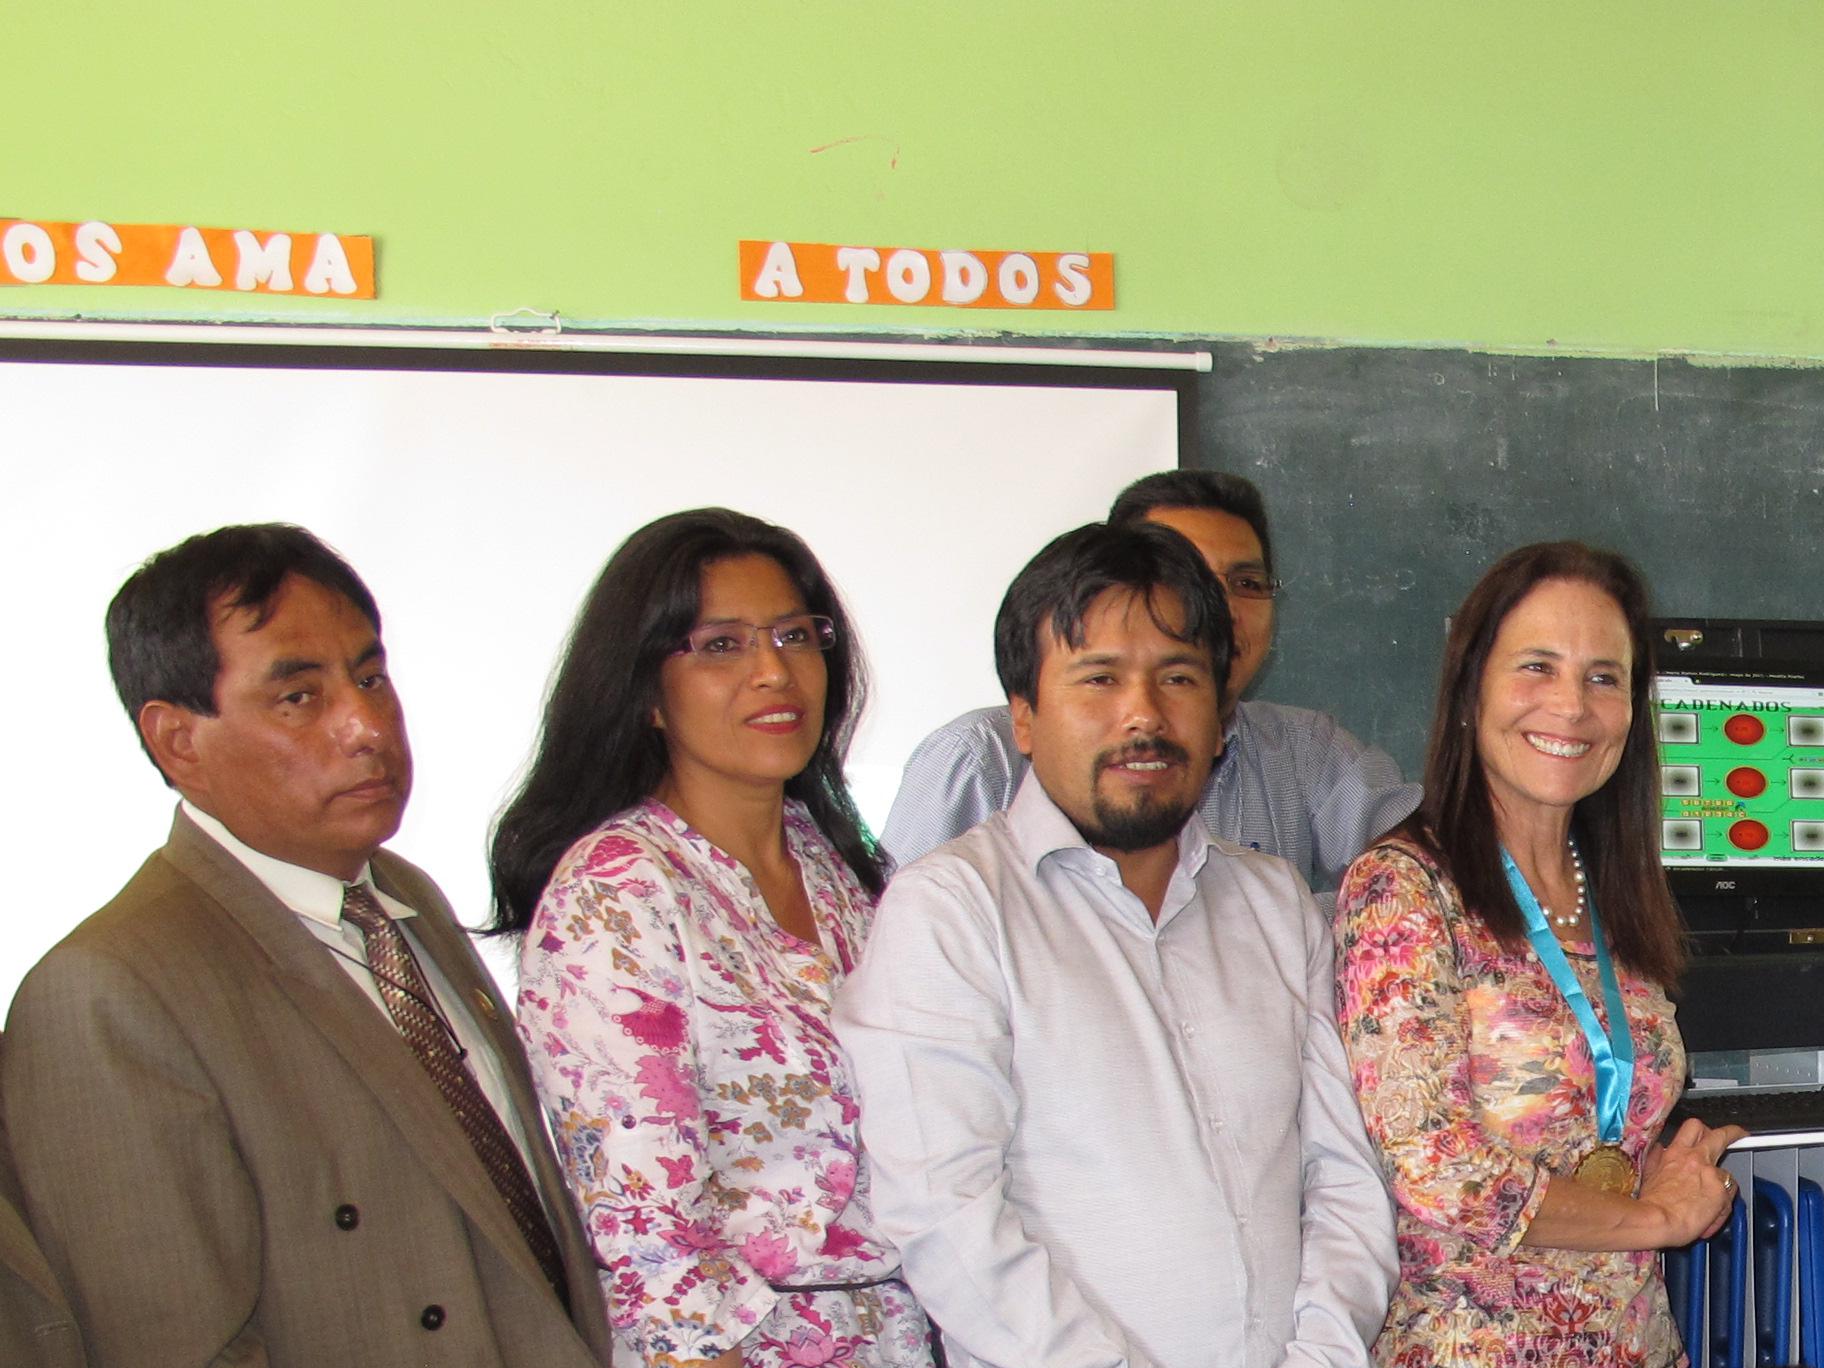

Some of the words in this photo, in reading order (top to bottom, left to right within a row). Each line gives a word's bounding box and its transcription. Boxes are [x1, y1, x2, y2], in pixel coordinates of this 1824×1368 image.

[3, 221, 122, 284] OS
[165, 226, 358, 294] AMA
[754, 241, 804, 298] A
[836, 246, 1093, 306] TODOS
[1715, 881, 1737, 890] AOC
